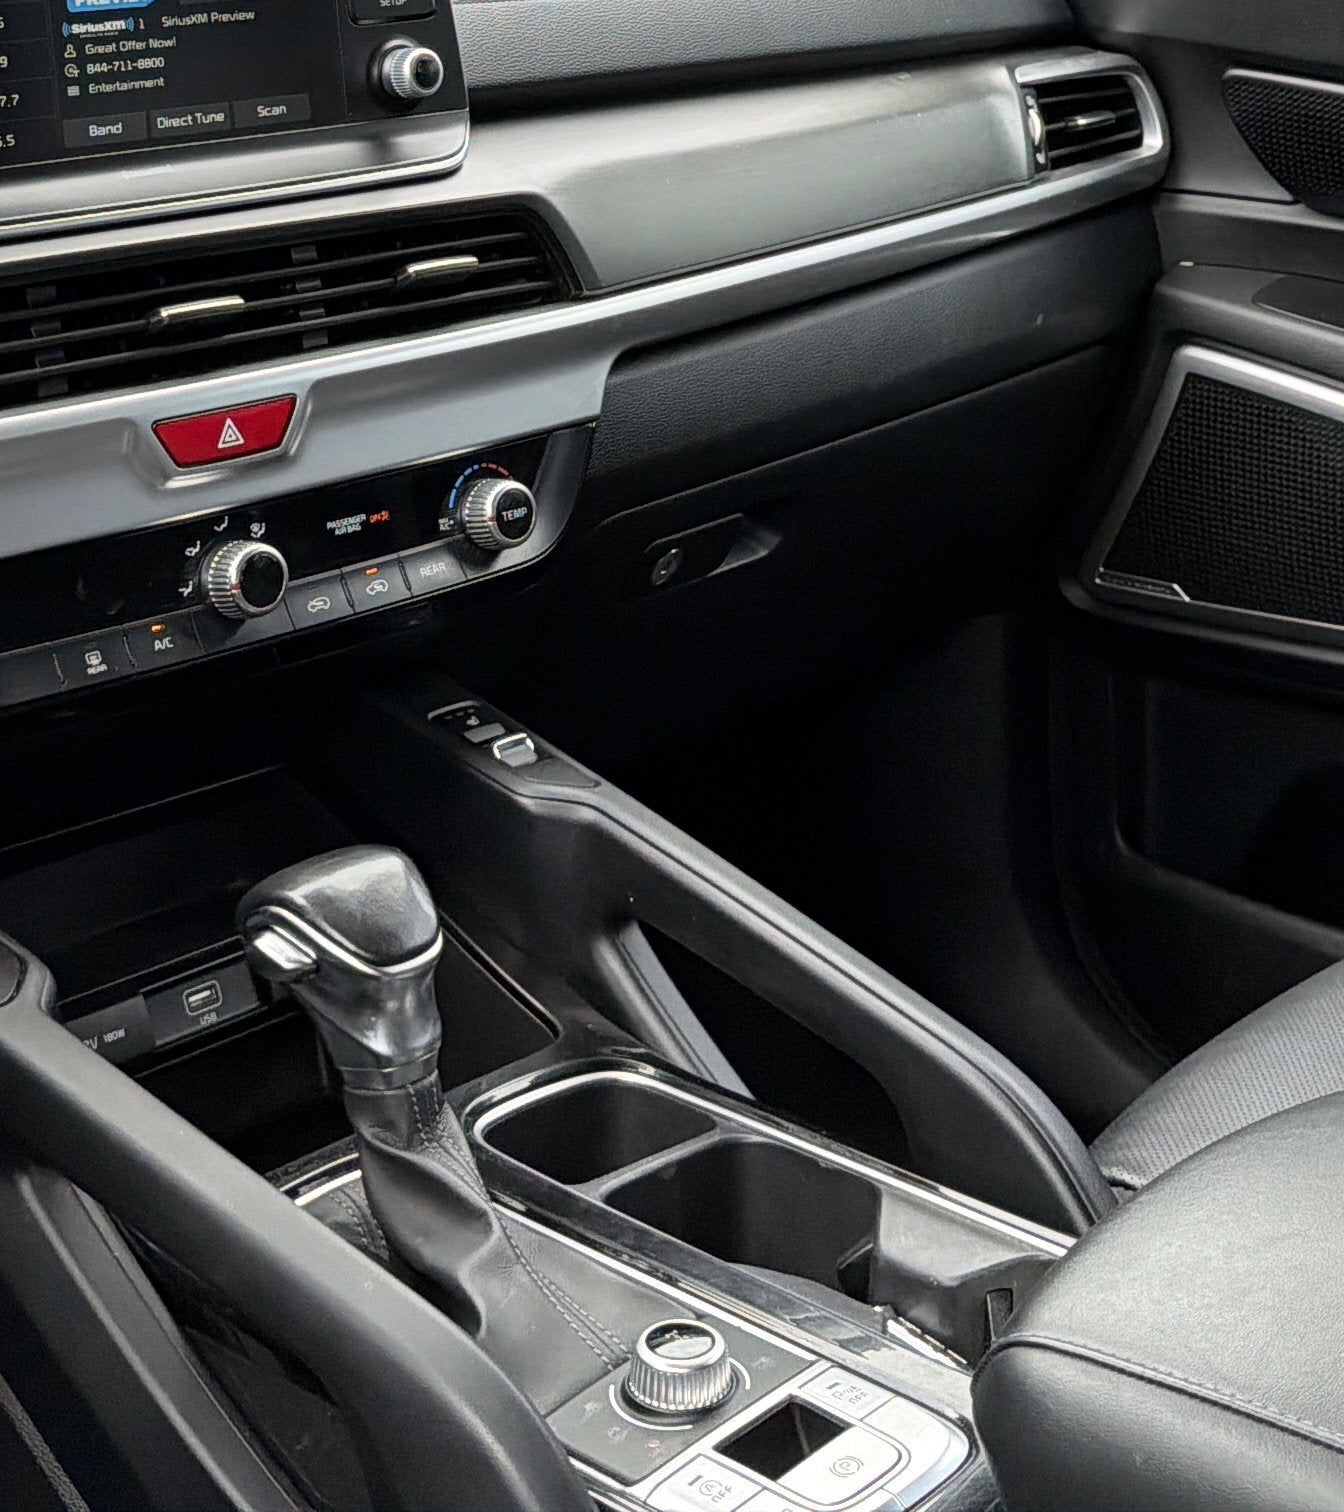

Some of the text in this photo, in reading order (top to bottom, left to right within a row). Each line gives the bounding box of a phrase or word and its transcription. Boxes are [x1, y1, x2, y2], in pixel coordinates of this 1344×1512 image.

[161, 14, 209, 28] SiriusXM
[210, 10, 255, 25] Preview
[85, 36, 177, 56] Great Offer Now!
[86, 56, 165, 75] 844-711-8800
[88, 76, 166, 94] Entertainment
[256, 104, 287, 118] Scan
[156, 110, 225, 130] Direct Tune
[88, 122, 123, 138] Band
[326, 513, 367, 531] PASSENGER
[501, 506, 528, 522] TEMP
[334, 526, 347, 536] AIR
[419, 562, 446, 578] REAR
[154, 637, 174, 652] A/C
[200, 1011, 218, 1026] USB
[711, 1485, 732, 1504] OFF
